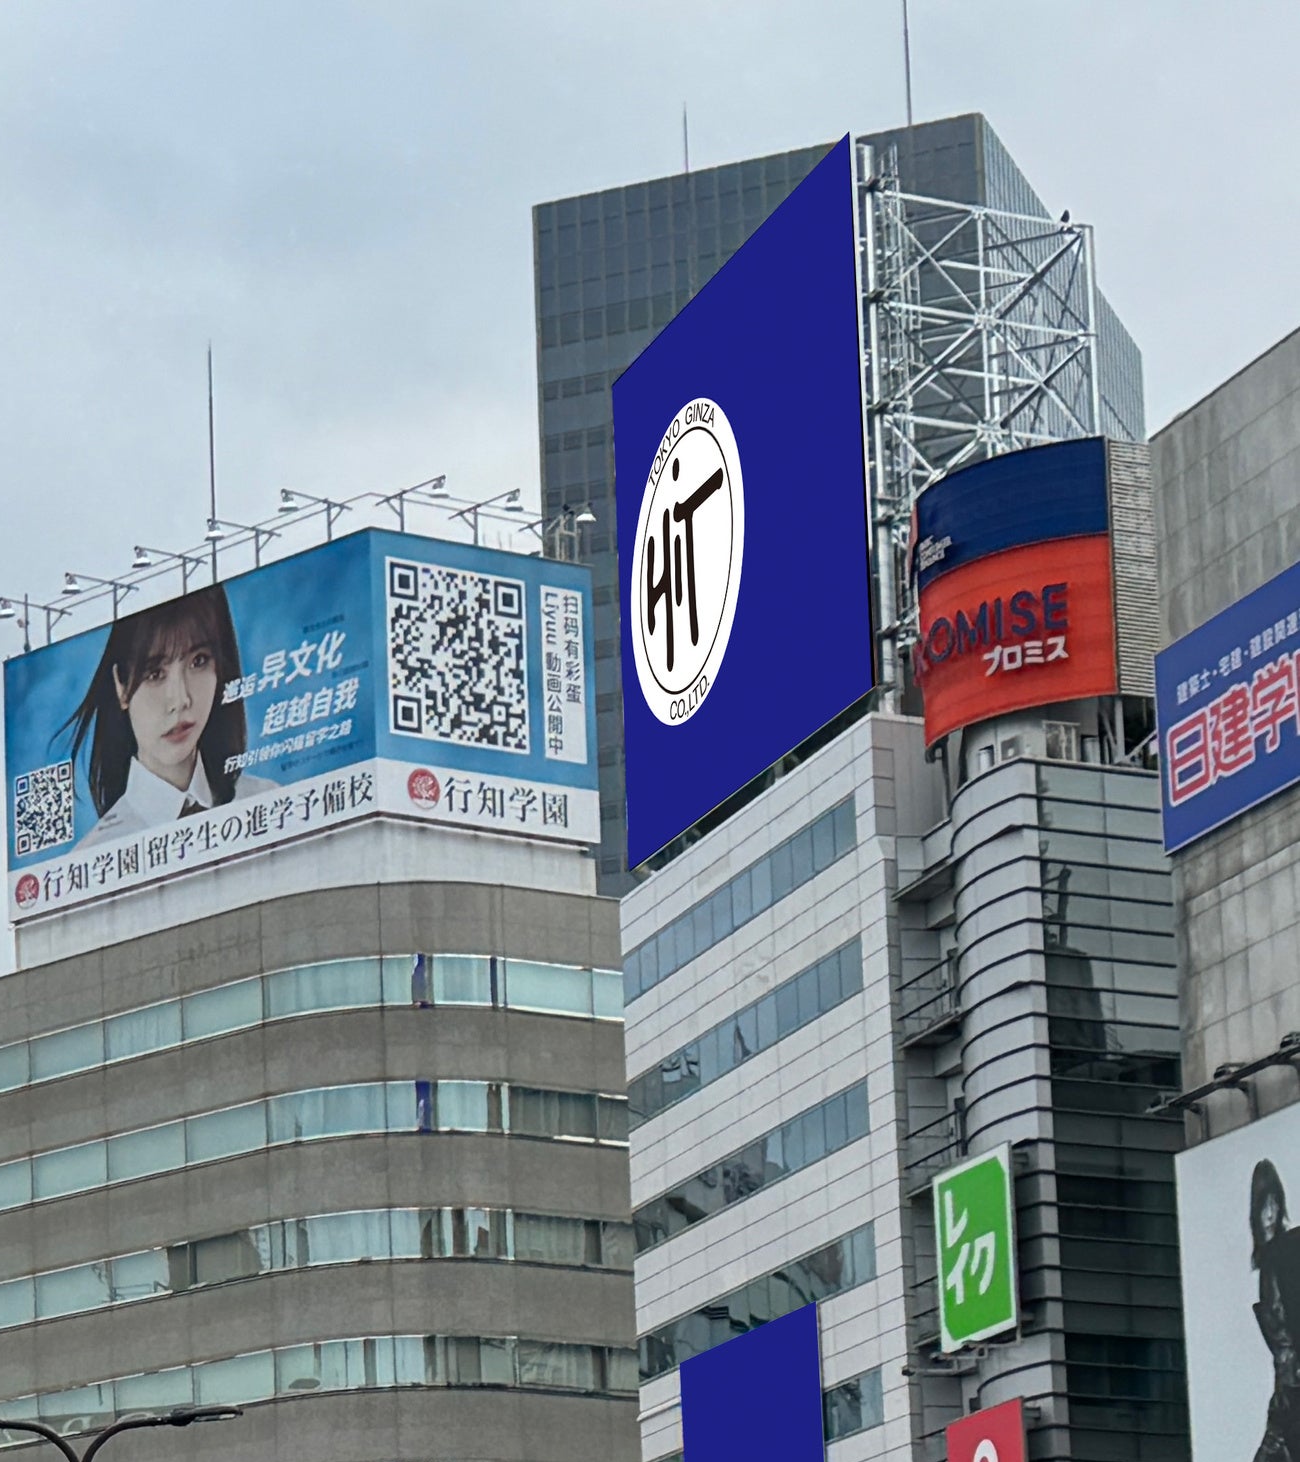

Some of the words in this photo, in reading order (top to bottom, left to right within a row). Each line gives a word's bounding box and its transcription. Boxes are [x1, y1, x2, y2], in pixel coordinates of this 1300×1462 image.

[648, 418, 681, 487] TOKYO
[685, 403, 716, 428] GINZA
[541, 591, 558, 645] Liyuu
[563, 594, 582, 705] 扫码有彩蛋
[982, 635, 1069, 677] プロミス
[261, 677, 360, 737] 超越自我
[545, 651, 564, 756] 動画公開中
[669, 675, 710, 720] CO.,LTD.
[1166, 648, 1300, 807] 日建学
[42, 842, 141, 902] 行知学園
[146, 770, 375, 870] 留学生の進学予備校
[443, 776, 569, 829] 行知学園
